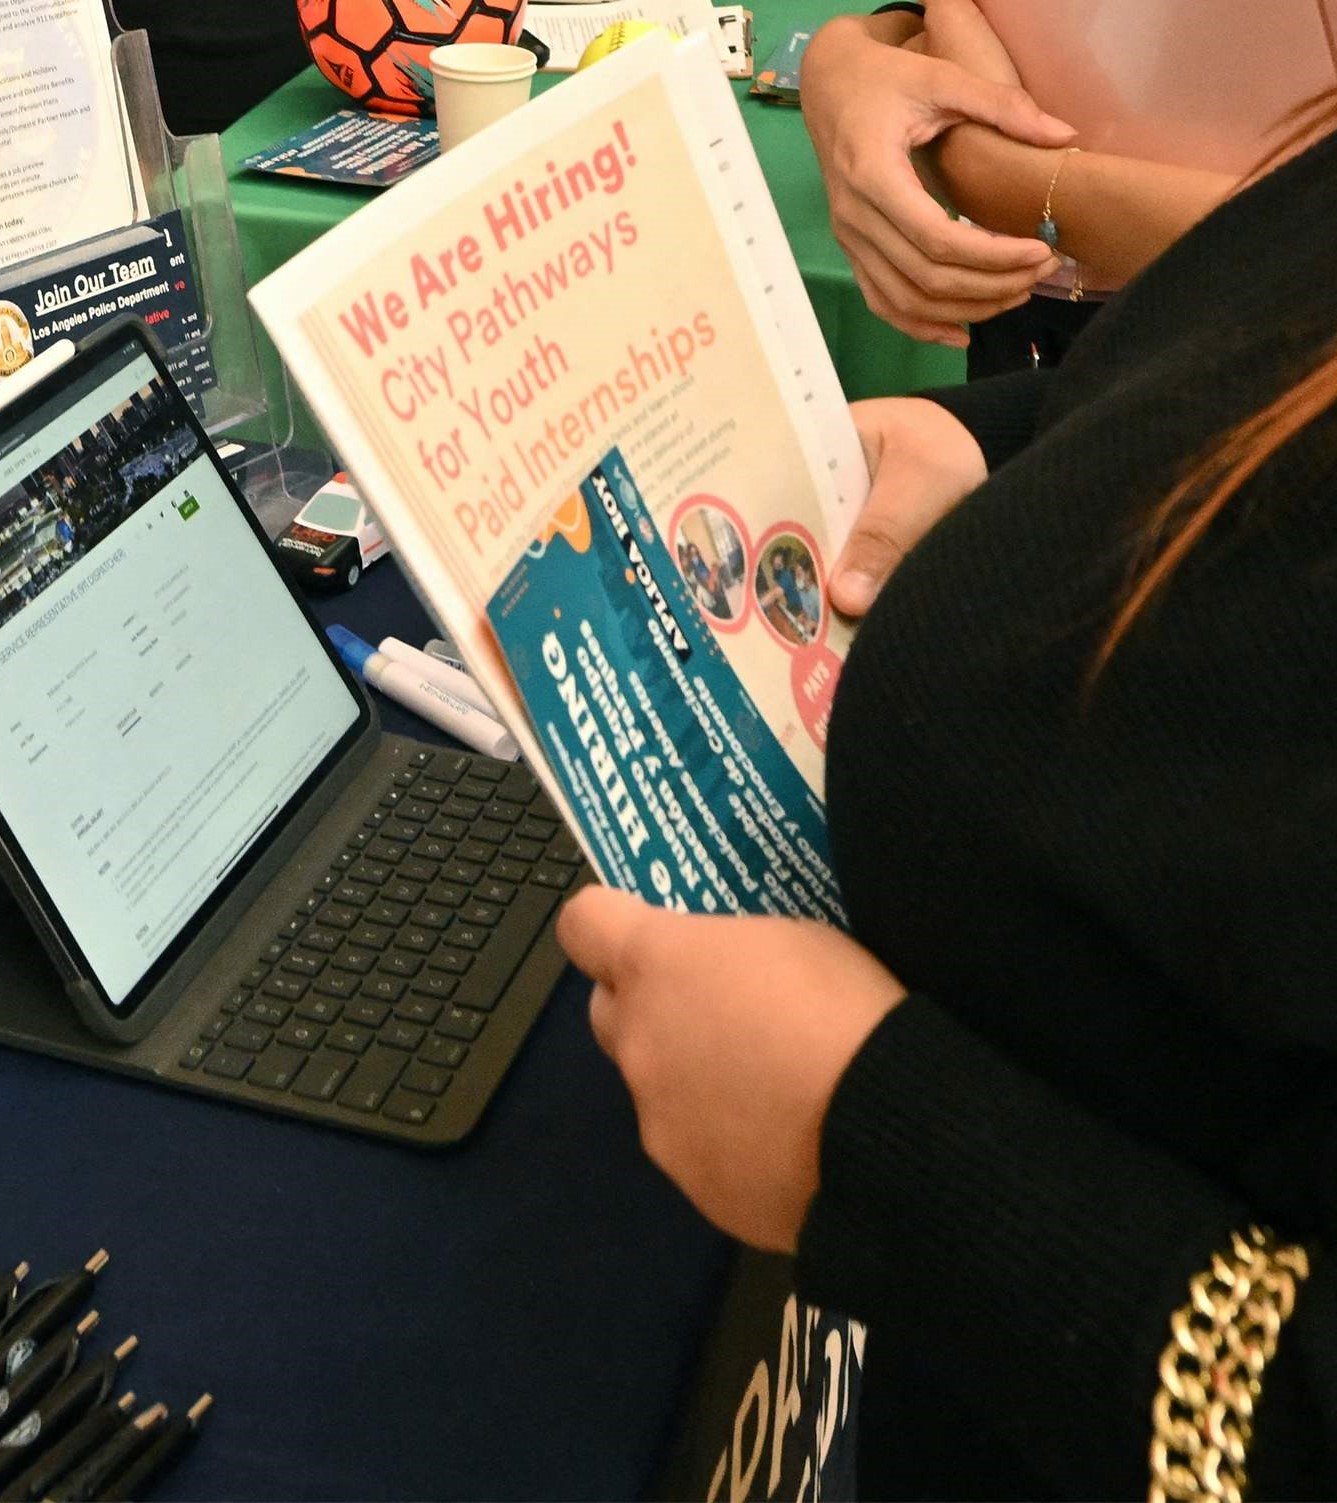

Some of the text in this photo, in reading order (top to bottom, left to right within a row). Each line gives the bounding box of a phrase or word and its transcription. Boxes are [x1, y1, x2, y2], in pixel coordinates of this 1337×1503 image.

[34, 255, 155, 311] Join Our Team
[339, 121, 637, 358] We Are Hiring!
[32, 281, 170, 341] Los Angeles Police Department
[380, 210, 639, 423] City Pathways
[416, 336, 570, 491] for Youth
[452, 310, 717, 556] Paid Internships
[23, 588, 79, 641] REPRESENTATIVE
[592, 477, 688, 650] APLICA HOY
[542, 632, 650, 856] HIRING
[577, 647, 640, 756] Equipo
[580, 620, 646, 750] Parques
[648, 619, 724, 754] Crecimiento
[693, 676, 786, 818] Emocionante
[802, 662, 831, 699] PAYS
[628, 671, 758, 892] Posiciones Abiertas
[631, 758, 701, 889] Nuestro
[723, 756, 745, 786] de
[728, 794, 790, 881] Flexible
